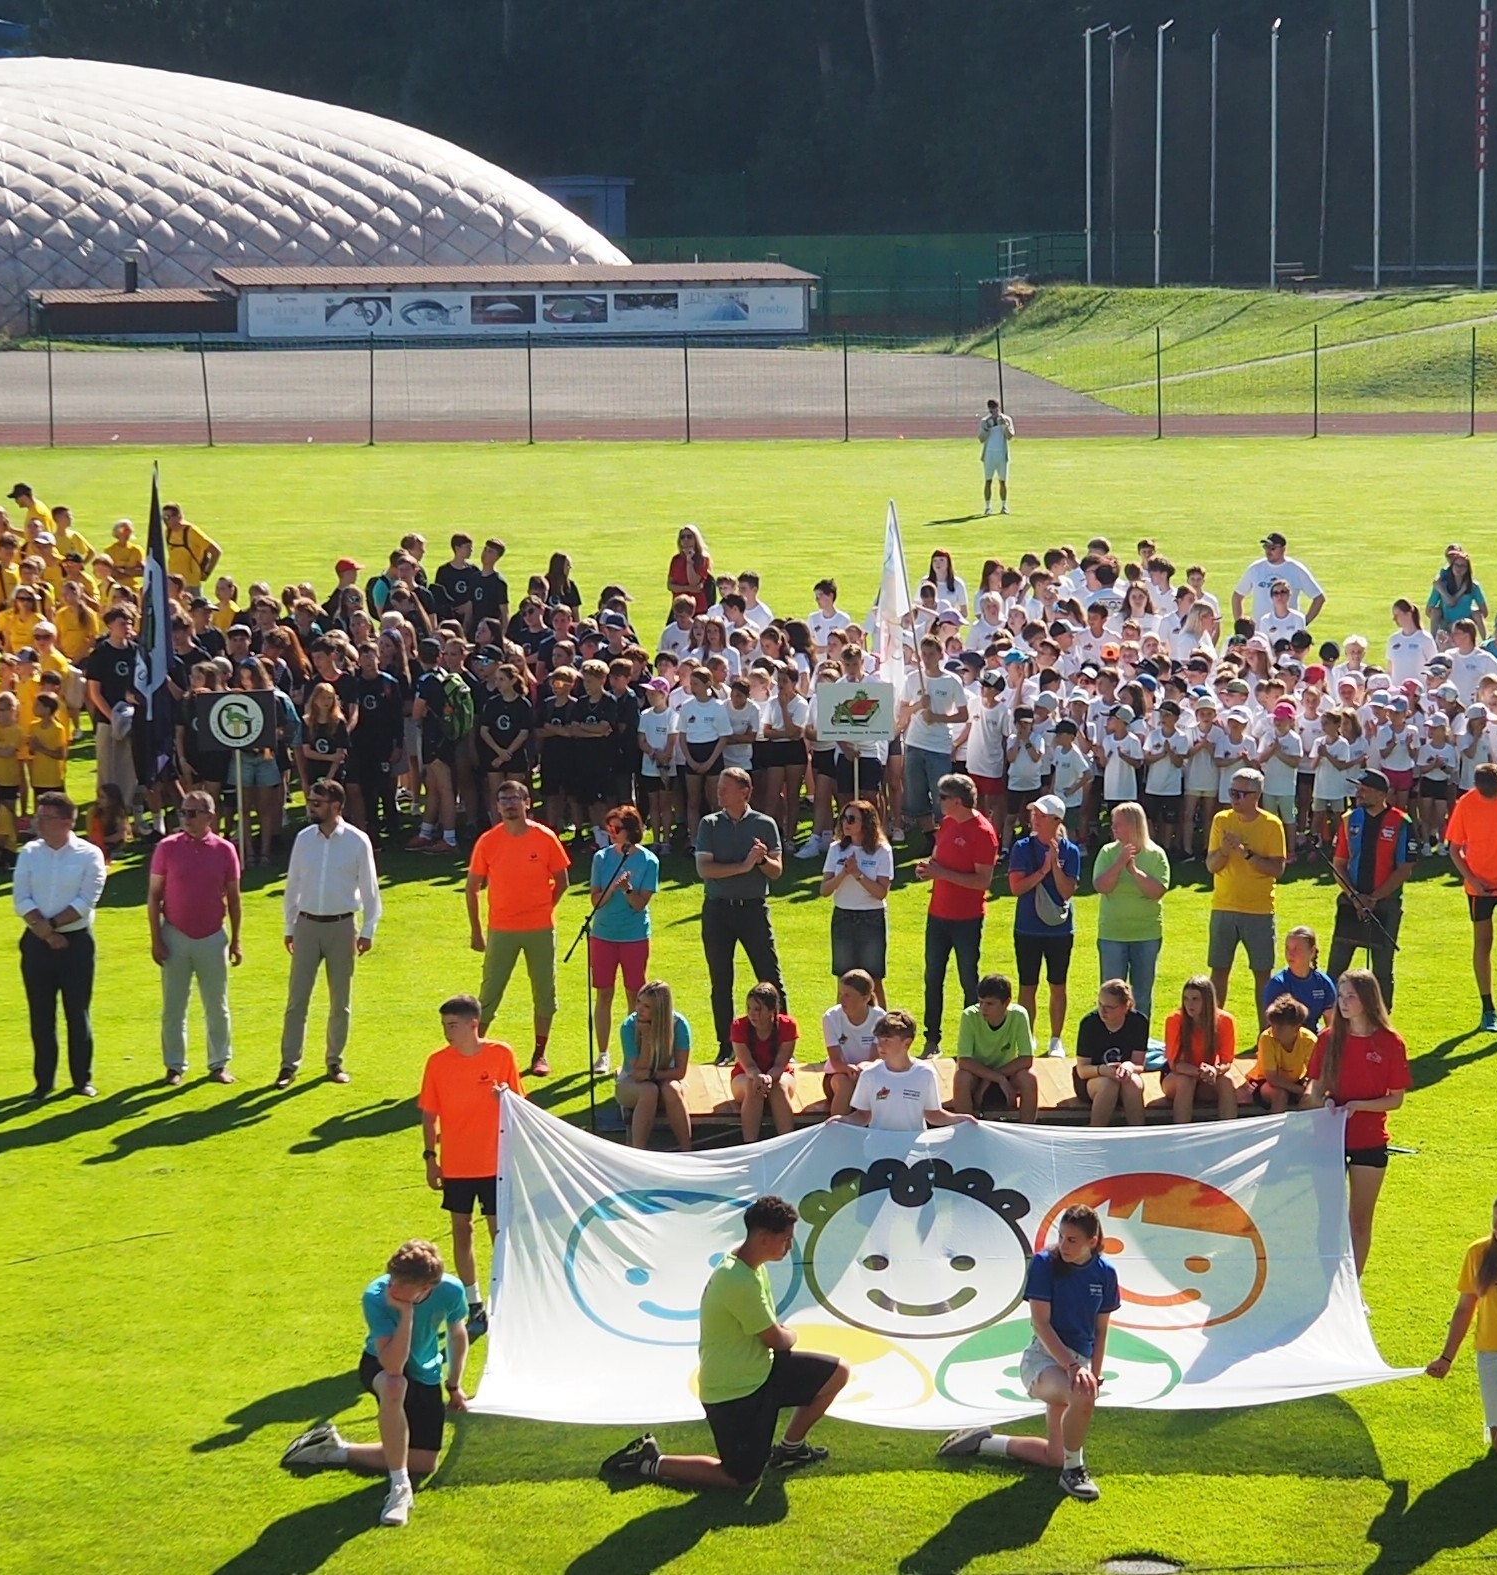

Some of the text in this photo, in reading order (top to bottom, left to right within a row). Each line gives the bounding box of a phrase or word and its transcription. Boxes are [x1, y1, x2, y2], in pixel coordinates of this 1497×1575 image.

[455, 580, 467, 594] G
[474, 587, 483, 601] G
[115, 660, 129, 676] G
[363, 694, 377, 710] G
[217, 702, 253, 740] G
[497, 714, 511, 731] G
[315, 738, 329, 754] G
